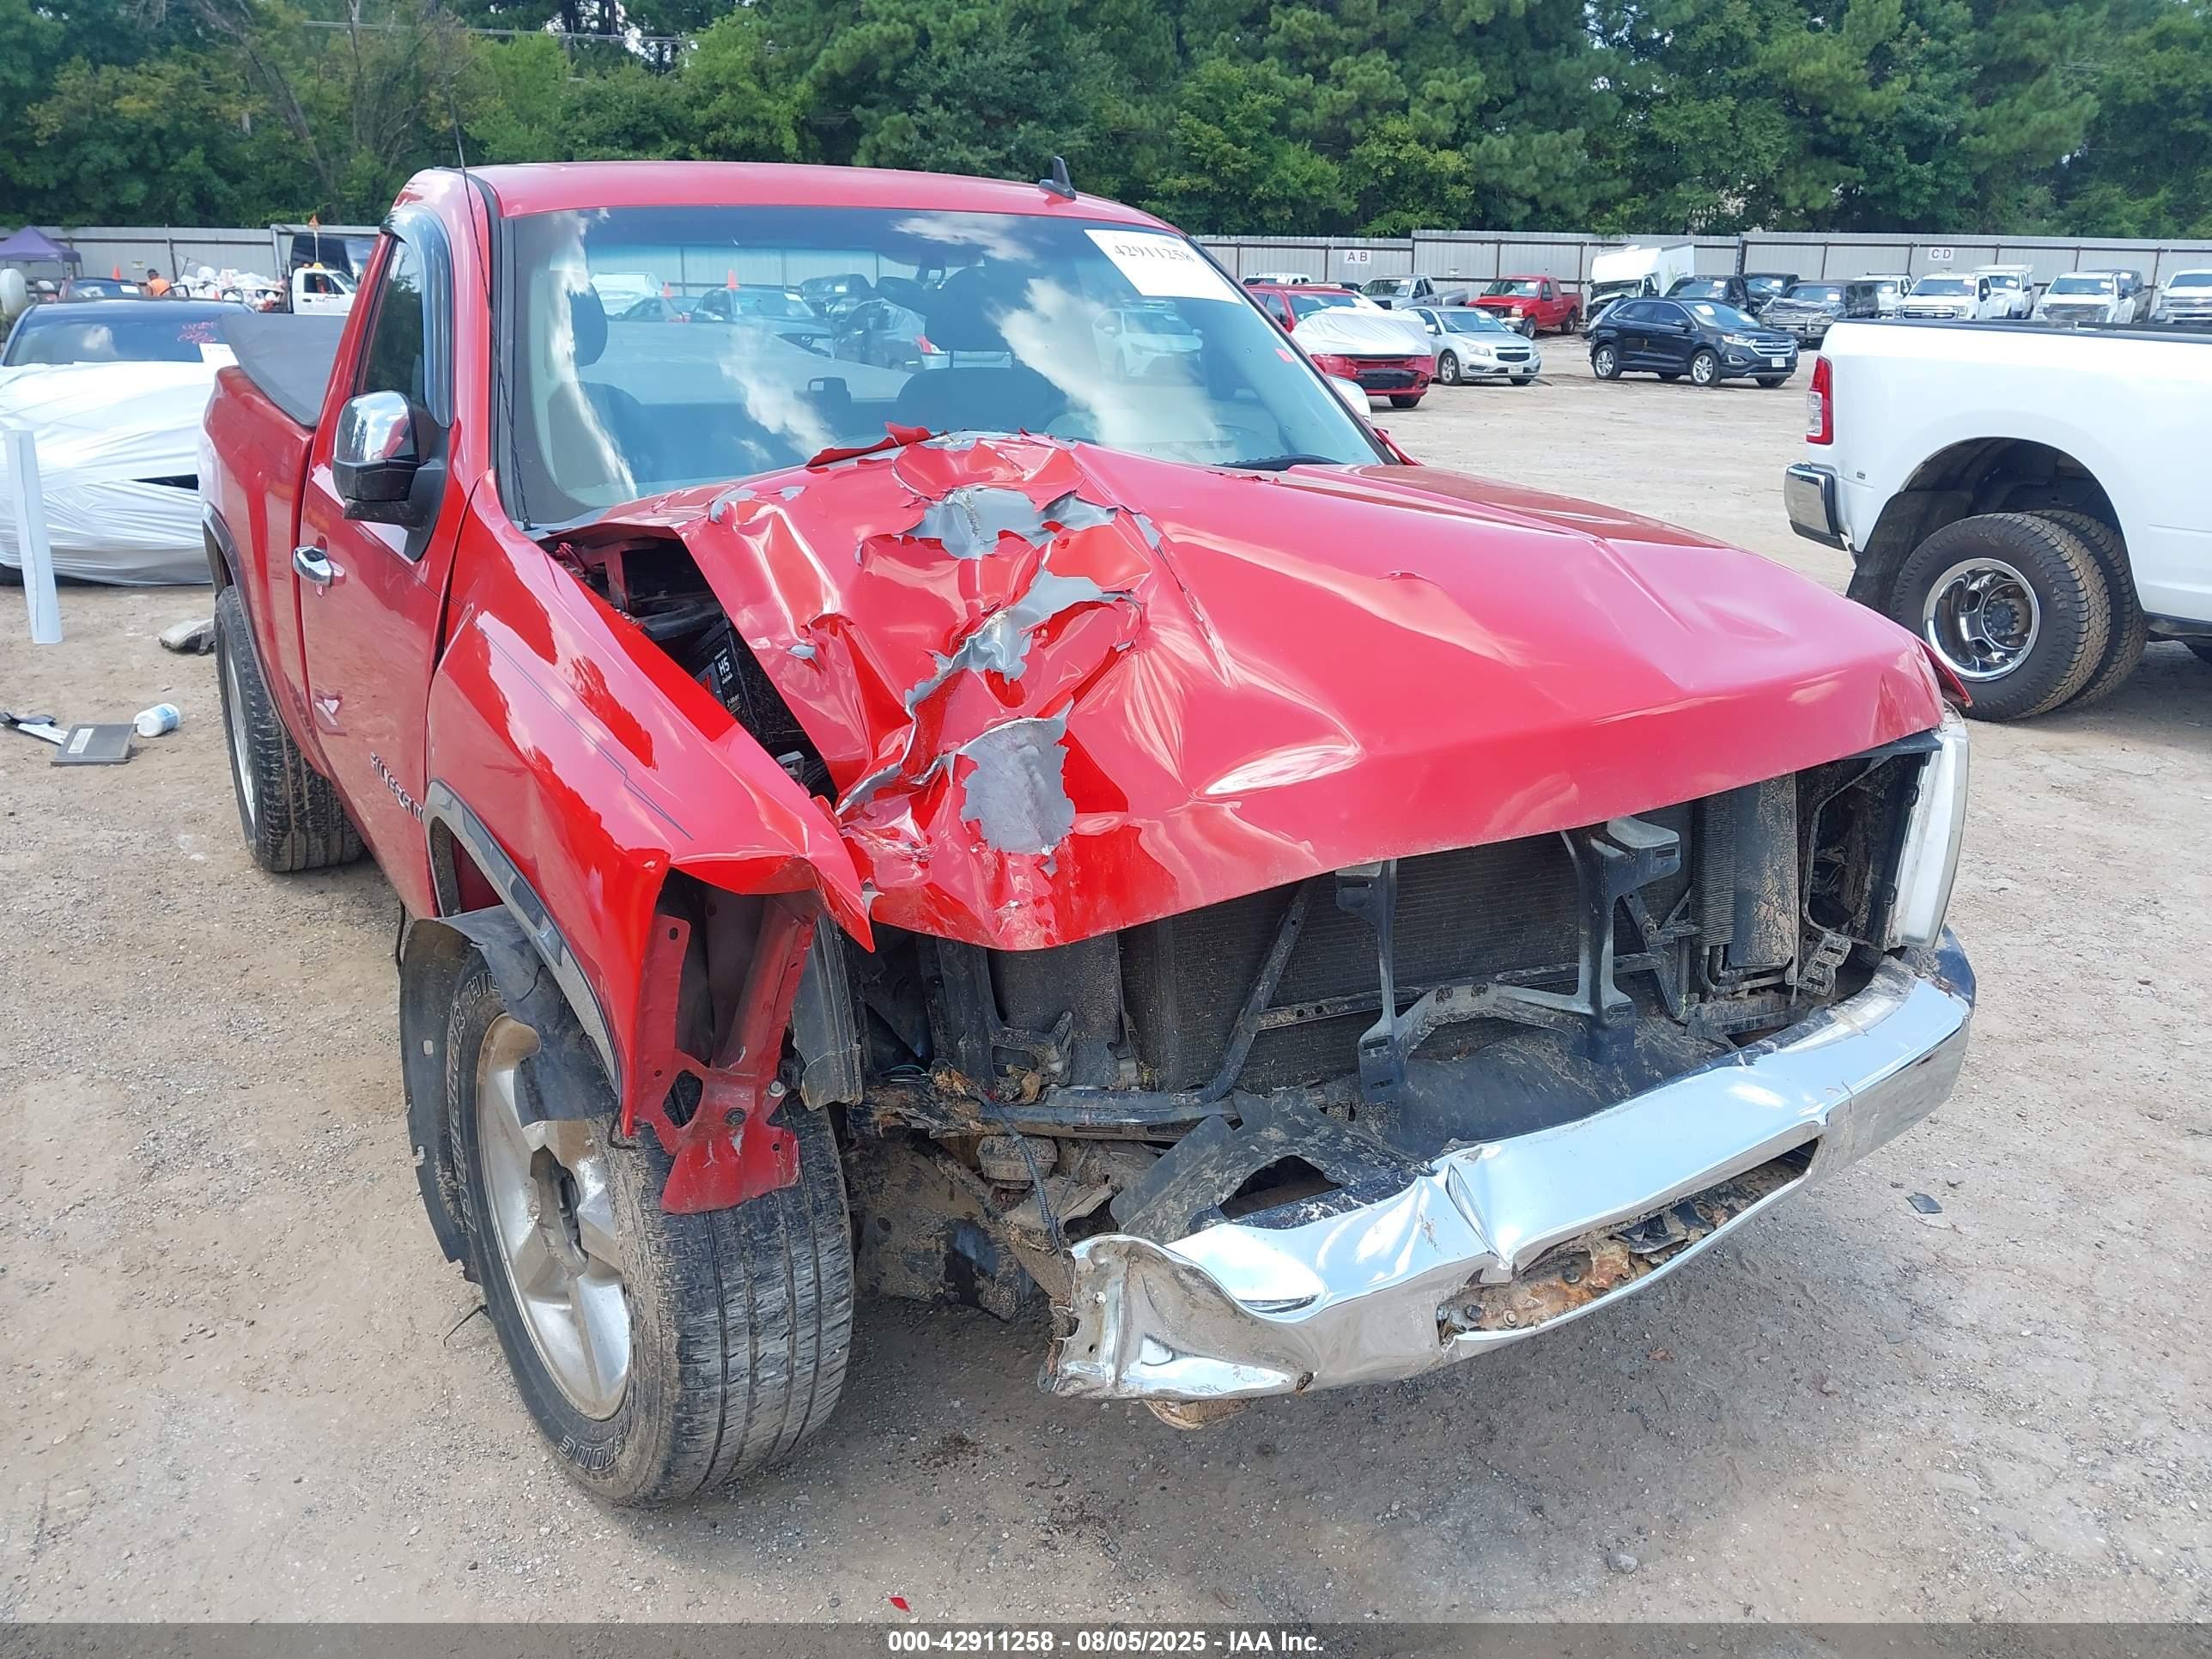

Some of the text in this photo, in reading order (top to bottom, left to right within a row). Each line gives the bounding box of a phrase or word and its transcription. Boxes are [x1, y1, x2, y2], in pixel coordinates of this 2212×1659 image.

[1346, 251, 1368, 262] A B
[1931, 248, 1951, 258] C D
[718, 655, 731, 677] H5
[446, 1004, 477, 1234] DUELER
